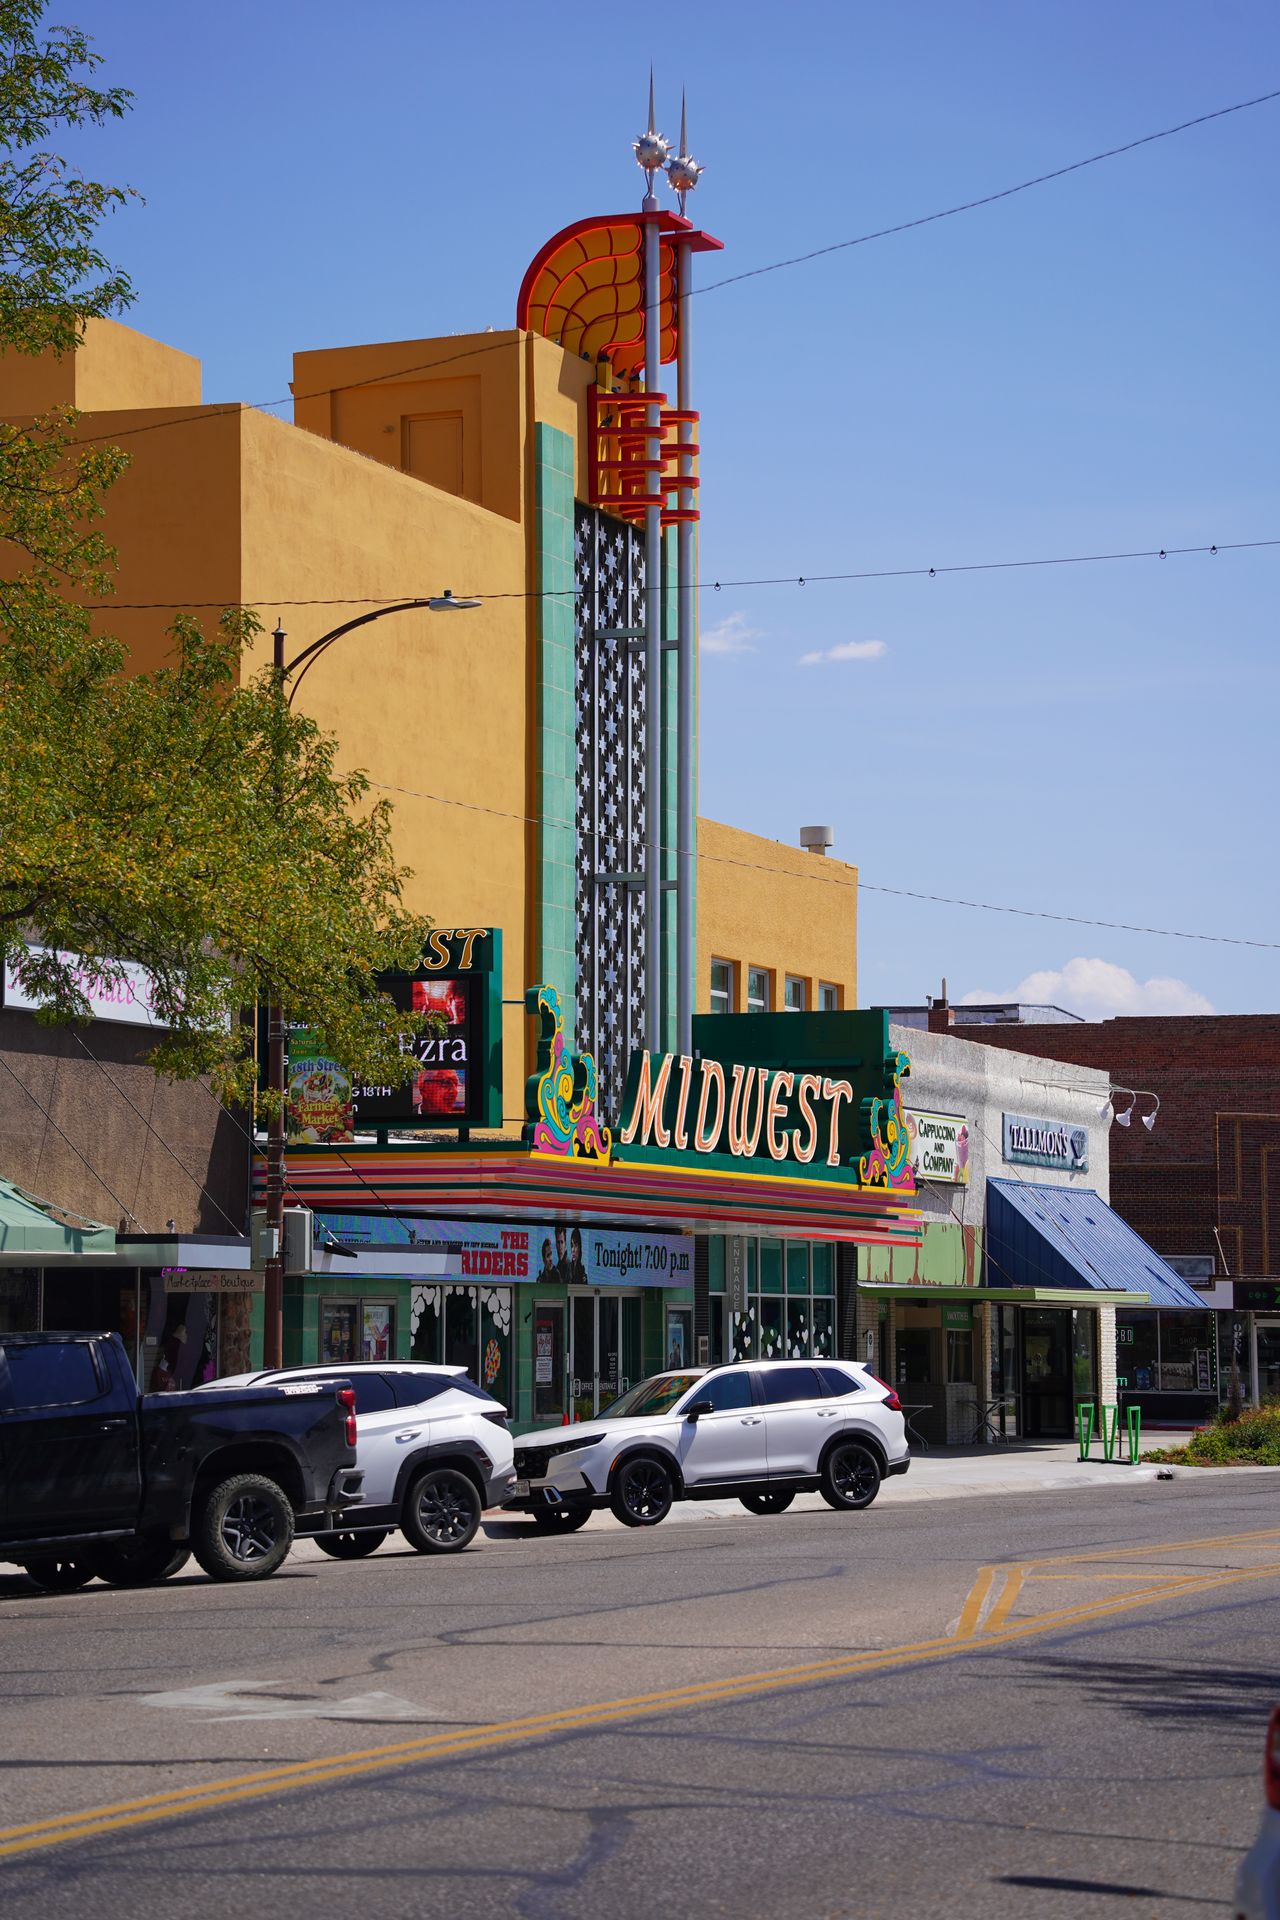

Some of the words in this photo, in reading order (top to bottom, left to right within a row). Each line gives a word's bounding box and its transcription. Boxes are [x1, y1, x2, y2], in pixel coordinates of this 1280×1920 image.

[397, 1032, 468, 1062] Ezra
[292, 1059, 315, 1073] 18th
[362, 1086, 392, 1097] 18TH
[298, 1102, 343, 1113] Farmer's
[620, 1049, 853, 1167] MIDWEST
[302, 1114, 339, 1125] Market
[933, 1142, 945, 1153] AND
[1011, 1124, 1069, 1157] TALLMON'S
[923, 1151, 956, 1174] COMPANY
[501, 1231, 529, 1250] THE
[594, 1242, 642, 1276] Tonight!
[645, 1244, 668, 1270] 7:00
[166, 1274, 212, 1291] Marketplace
[220, 1273, 256, 1291] Boutique
